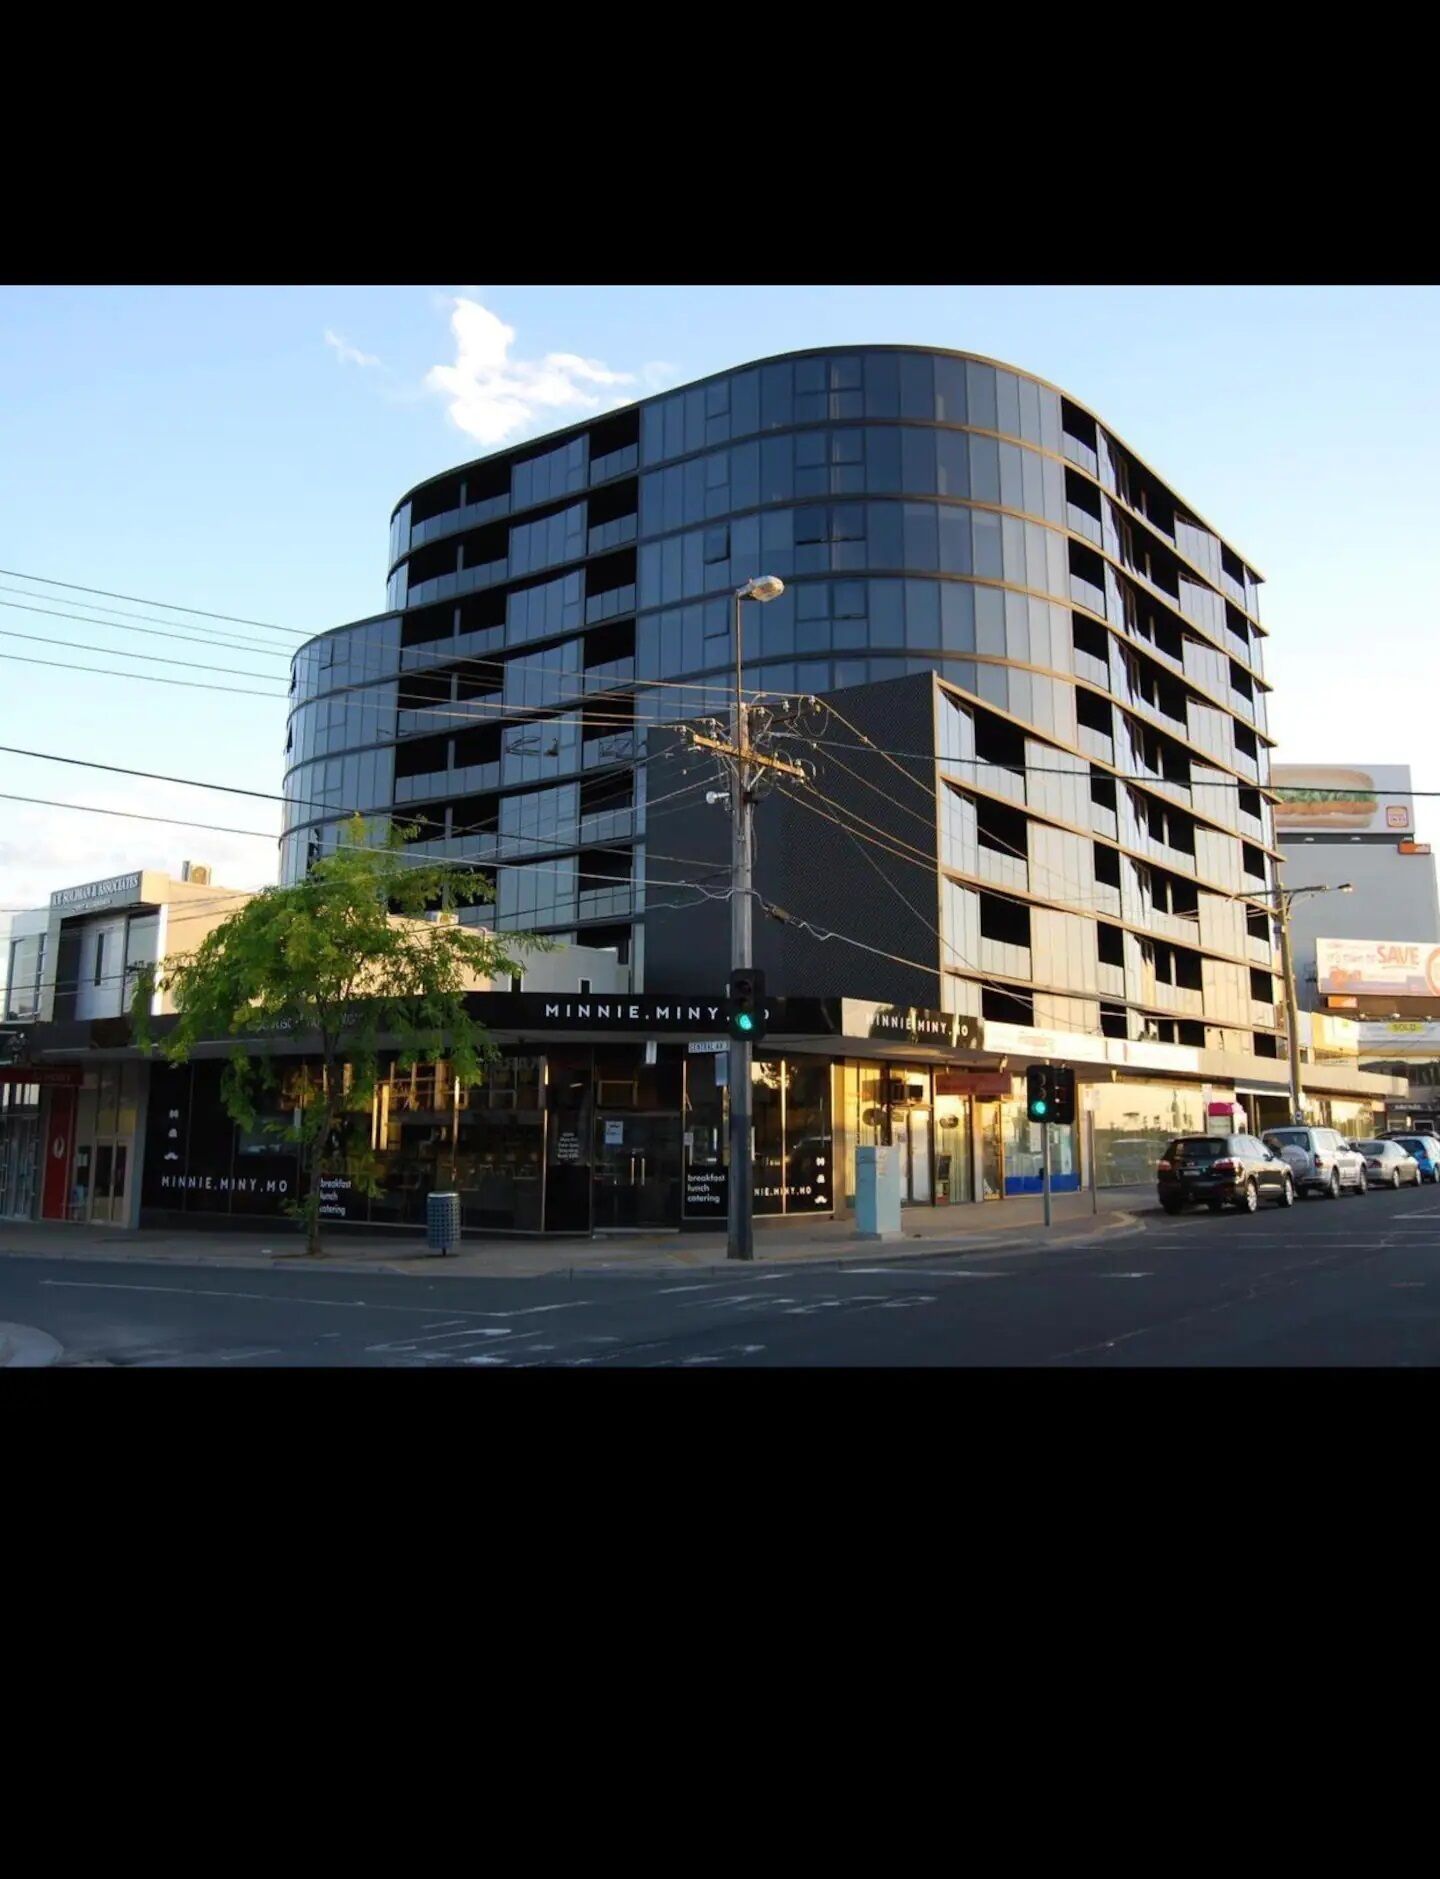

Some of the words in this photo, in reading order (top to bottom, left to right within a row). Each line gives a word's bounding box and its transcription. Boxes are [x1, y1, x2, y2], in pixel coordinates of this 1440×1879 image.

[1376, 943, 1420, 967] SAVE
[545, 1004, 769, 1020] MINNIE.MINY.
[161, 1176, 288, 1192] MINNIE.MINY.MO
[687, 1173, 725, 1182] breakfast
[687, 1184, 710, 1192] lunch
[687, 1193, 720, 1203] catering
